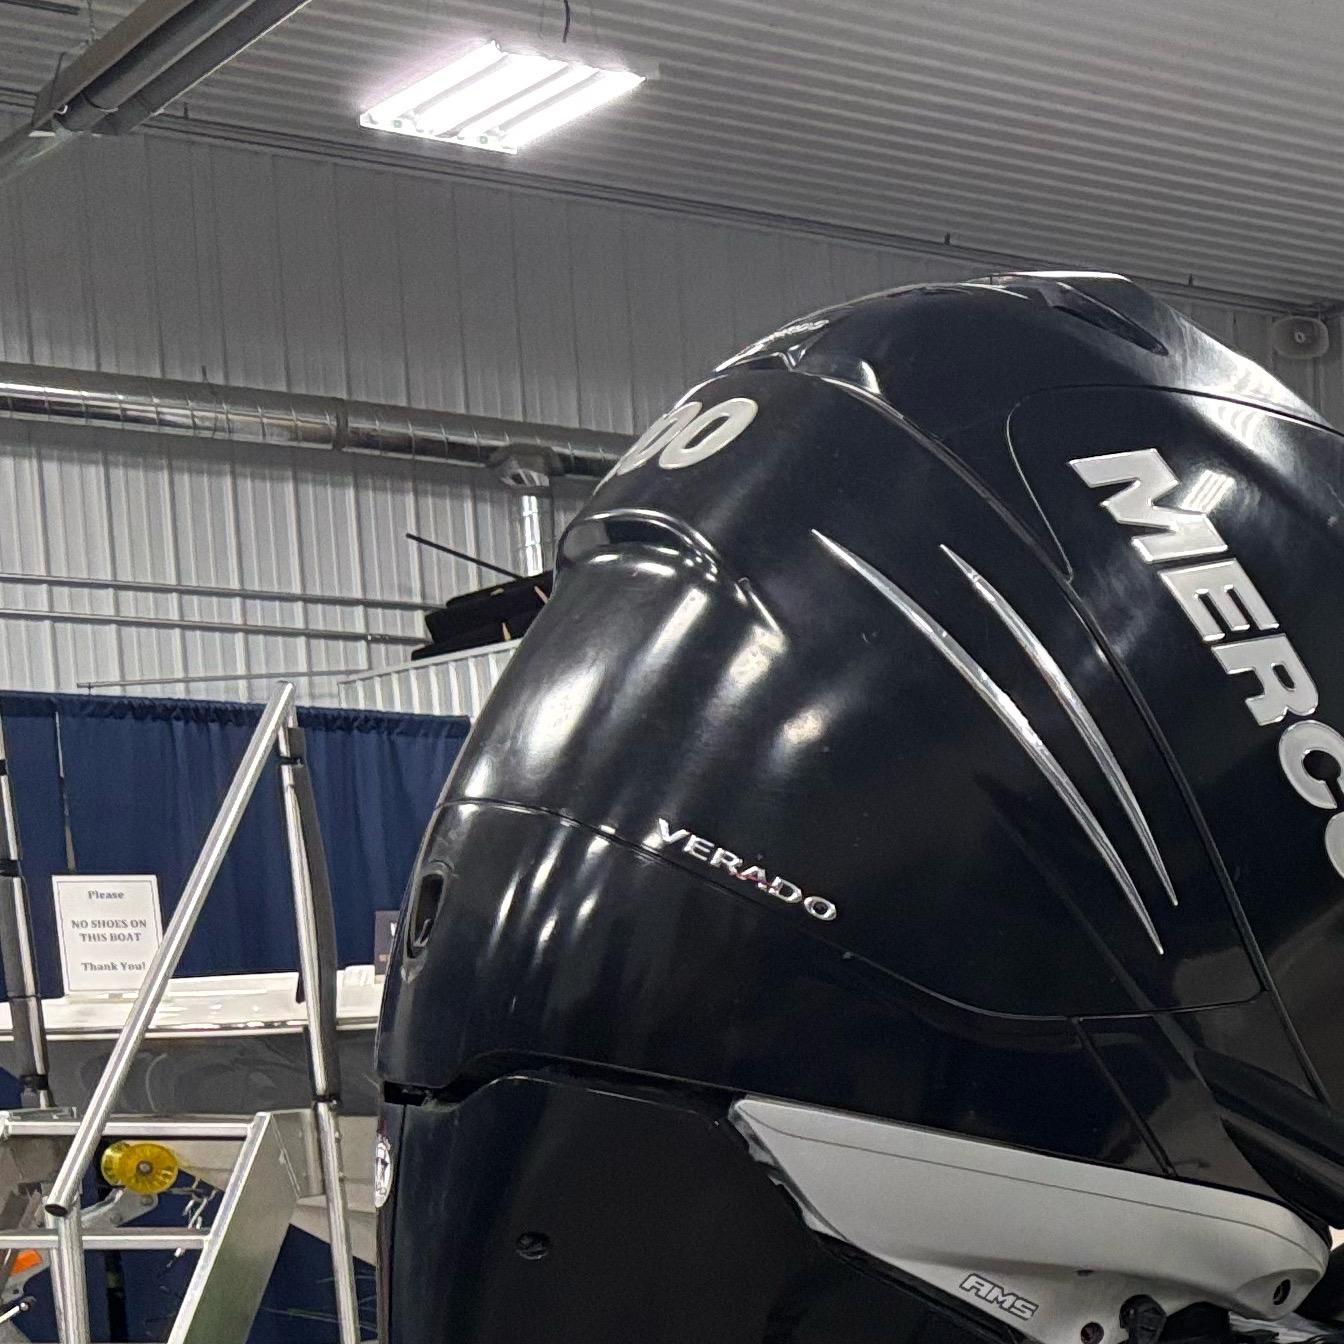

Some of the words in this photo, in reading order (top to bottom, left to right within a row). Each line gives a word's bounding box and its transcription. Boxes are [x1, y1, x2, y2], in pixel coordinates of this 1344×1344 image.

[658, 818, 837, 921] VERADO
[88, 890, 124, 900] Please
[71, 920, 88, 928] NO
[91, 920, 128, 928] SHOES
[130, 920, 147, 928] ON
[79, 933, 107, 942] THIS
[110, 933, 141, 942] BOAT
[81, 962, 118, 971] Thank
[120, 961, 146, 971] You!
[959, 1273, 1039, 1321] AMS
